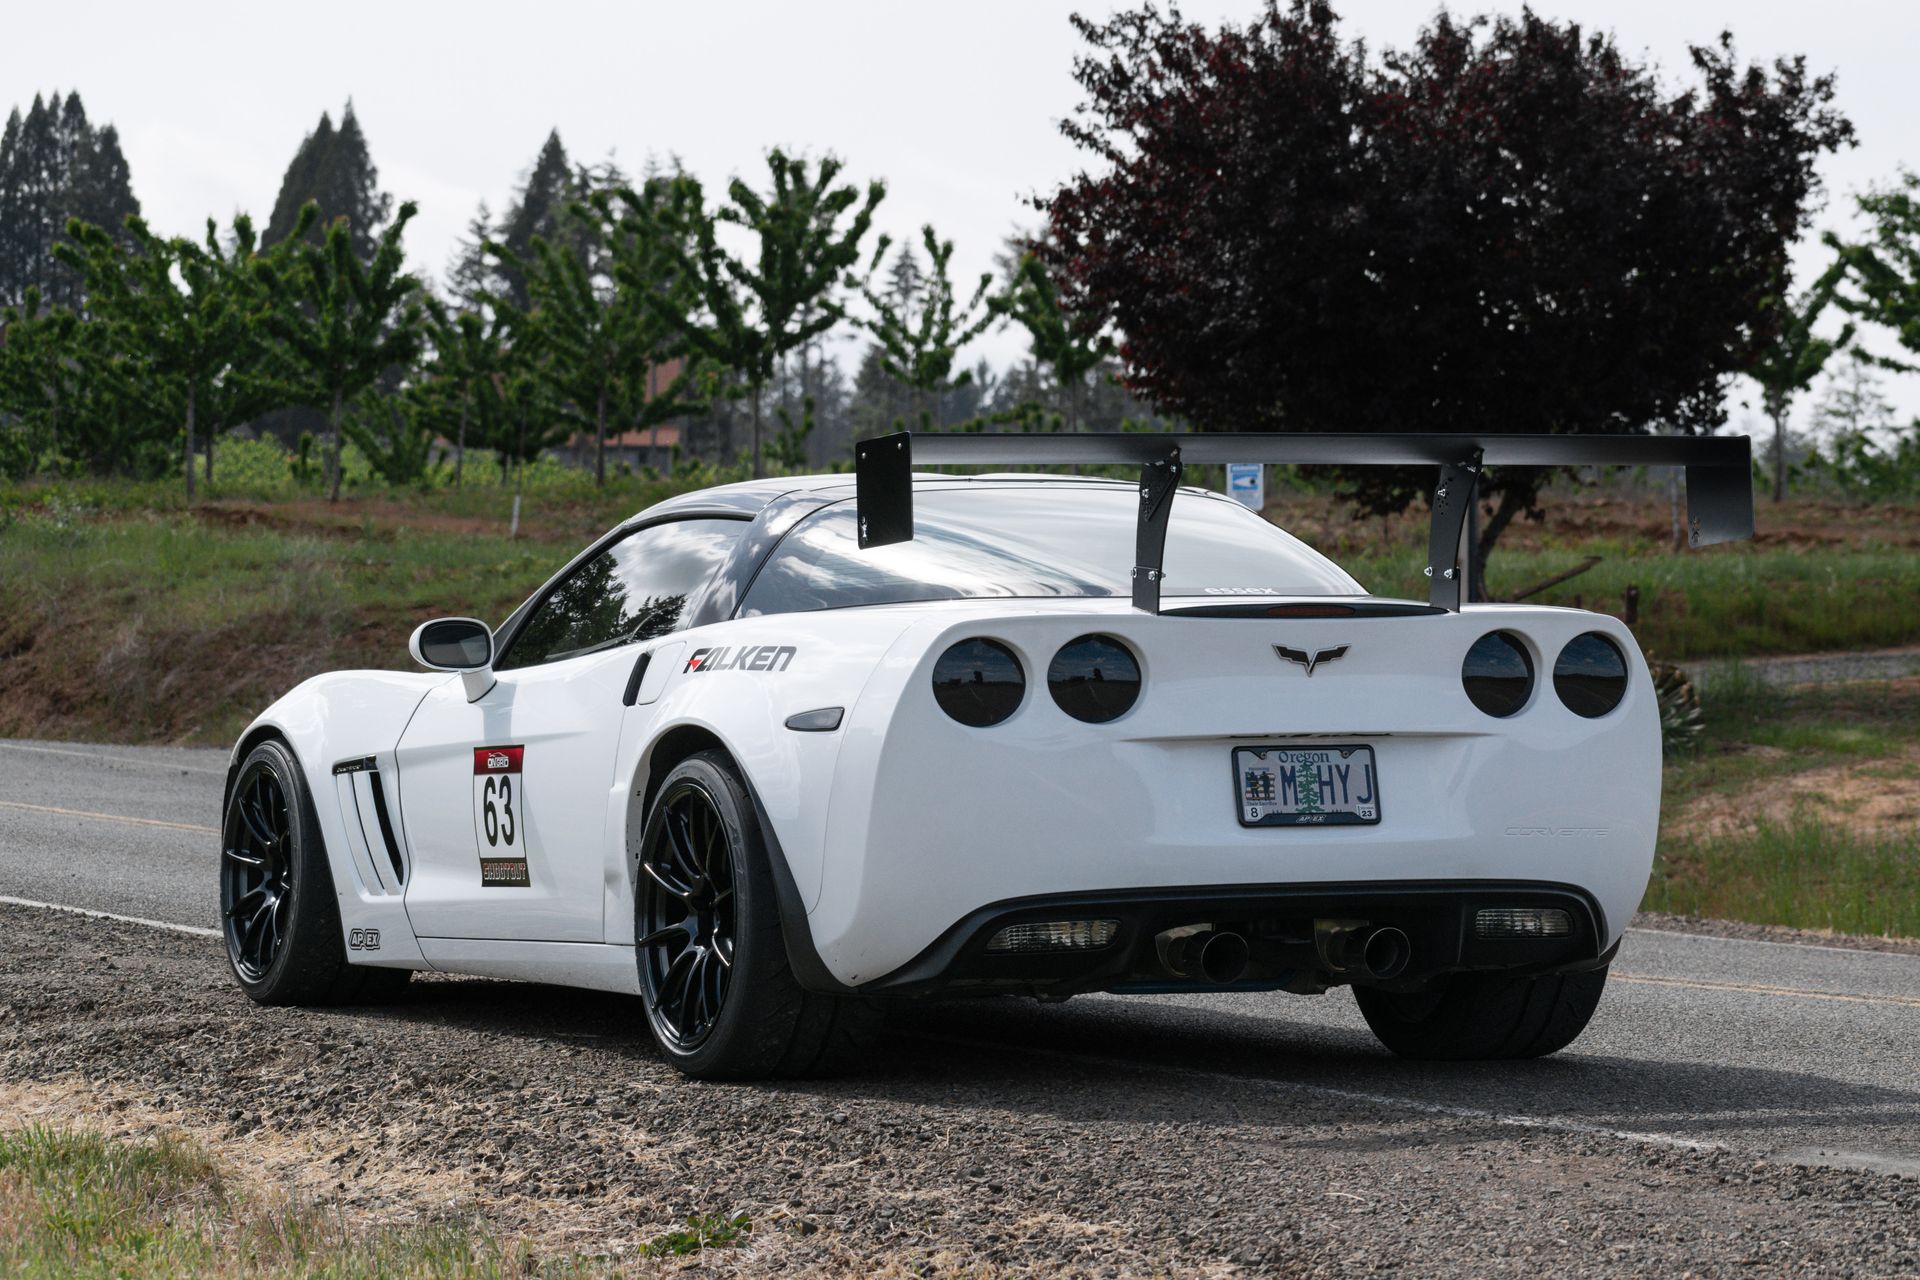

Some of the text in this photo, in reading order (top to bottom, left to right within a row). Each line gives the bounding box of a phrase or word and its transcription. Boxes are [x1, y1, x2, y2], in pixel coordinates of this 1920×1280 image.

[683, 646, 797, 674] FALKEN
[1278, 751, 1330, 766] Oregon
[483, 775, 515, 847] 63
[1251, 807, 1259, 817] 8
